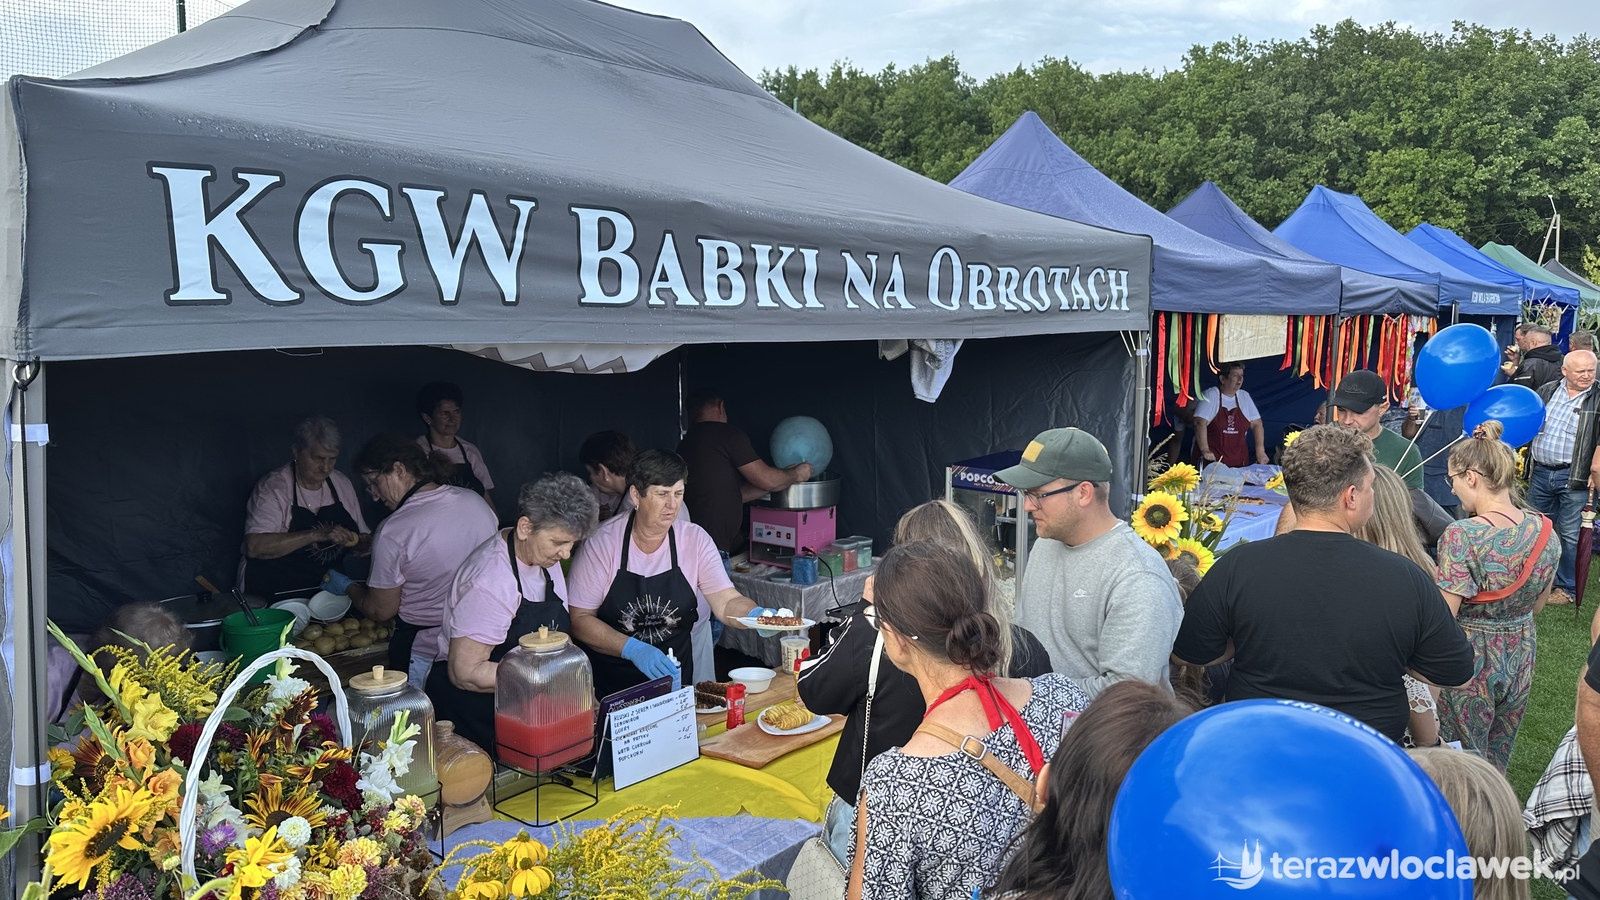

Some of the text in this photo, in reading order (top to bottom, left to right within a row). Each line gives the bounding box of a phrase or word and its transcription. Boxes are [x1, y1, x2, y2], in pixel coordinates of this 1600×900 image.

[150, 163, 1132, 313] KGW BABKI NA OBROTACH
[960, 471, 1009, 487] POPCO
